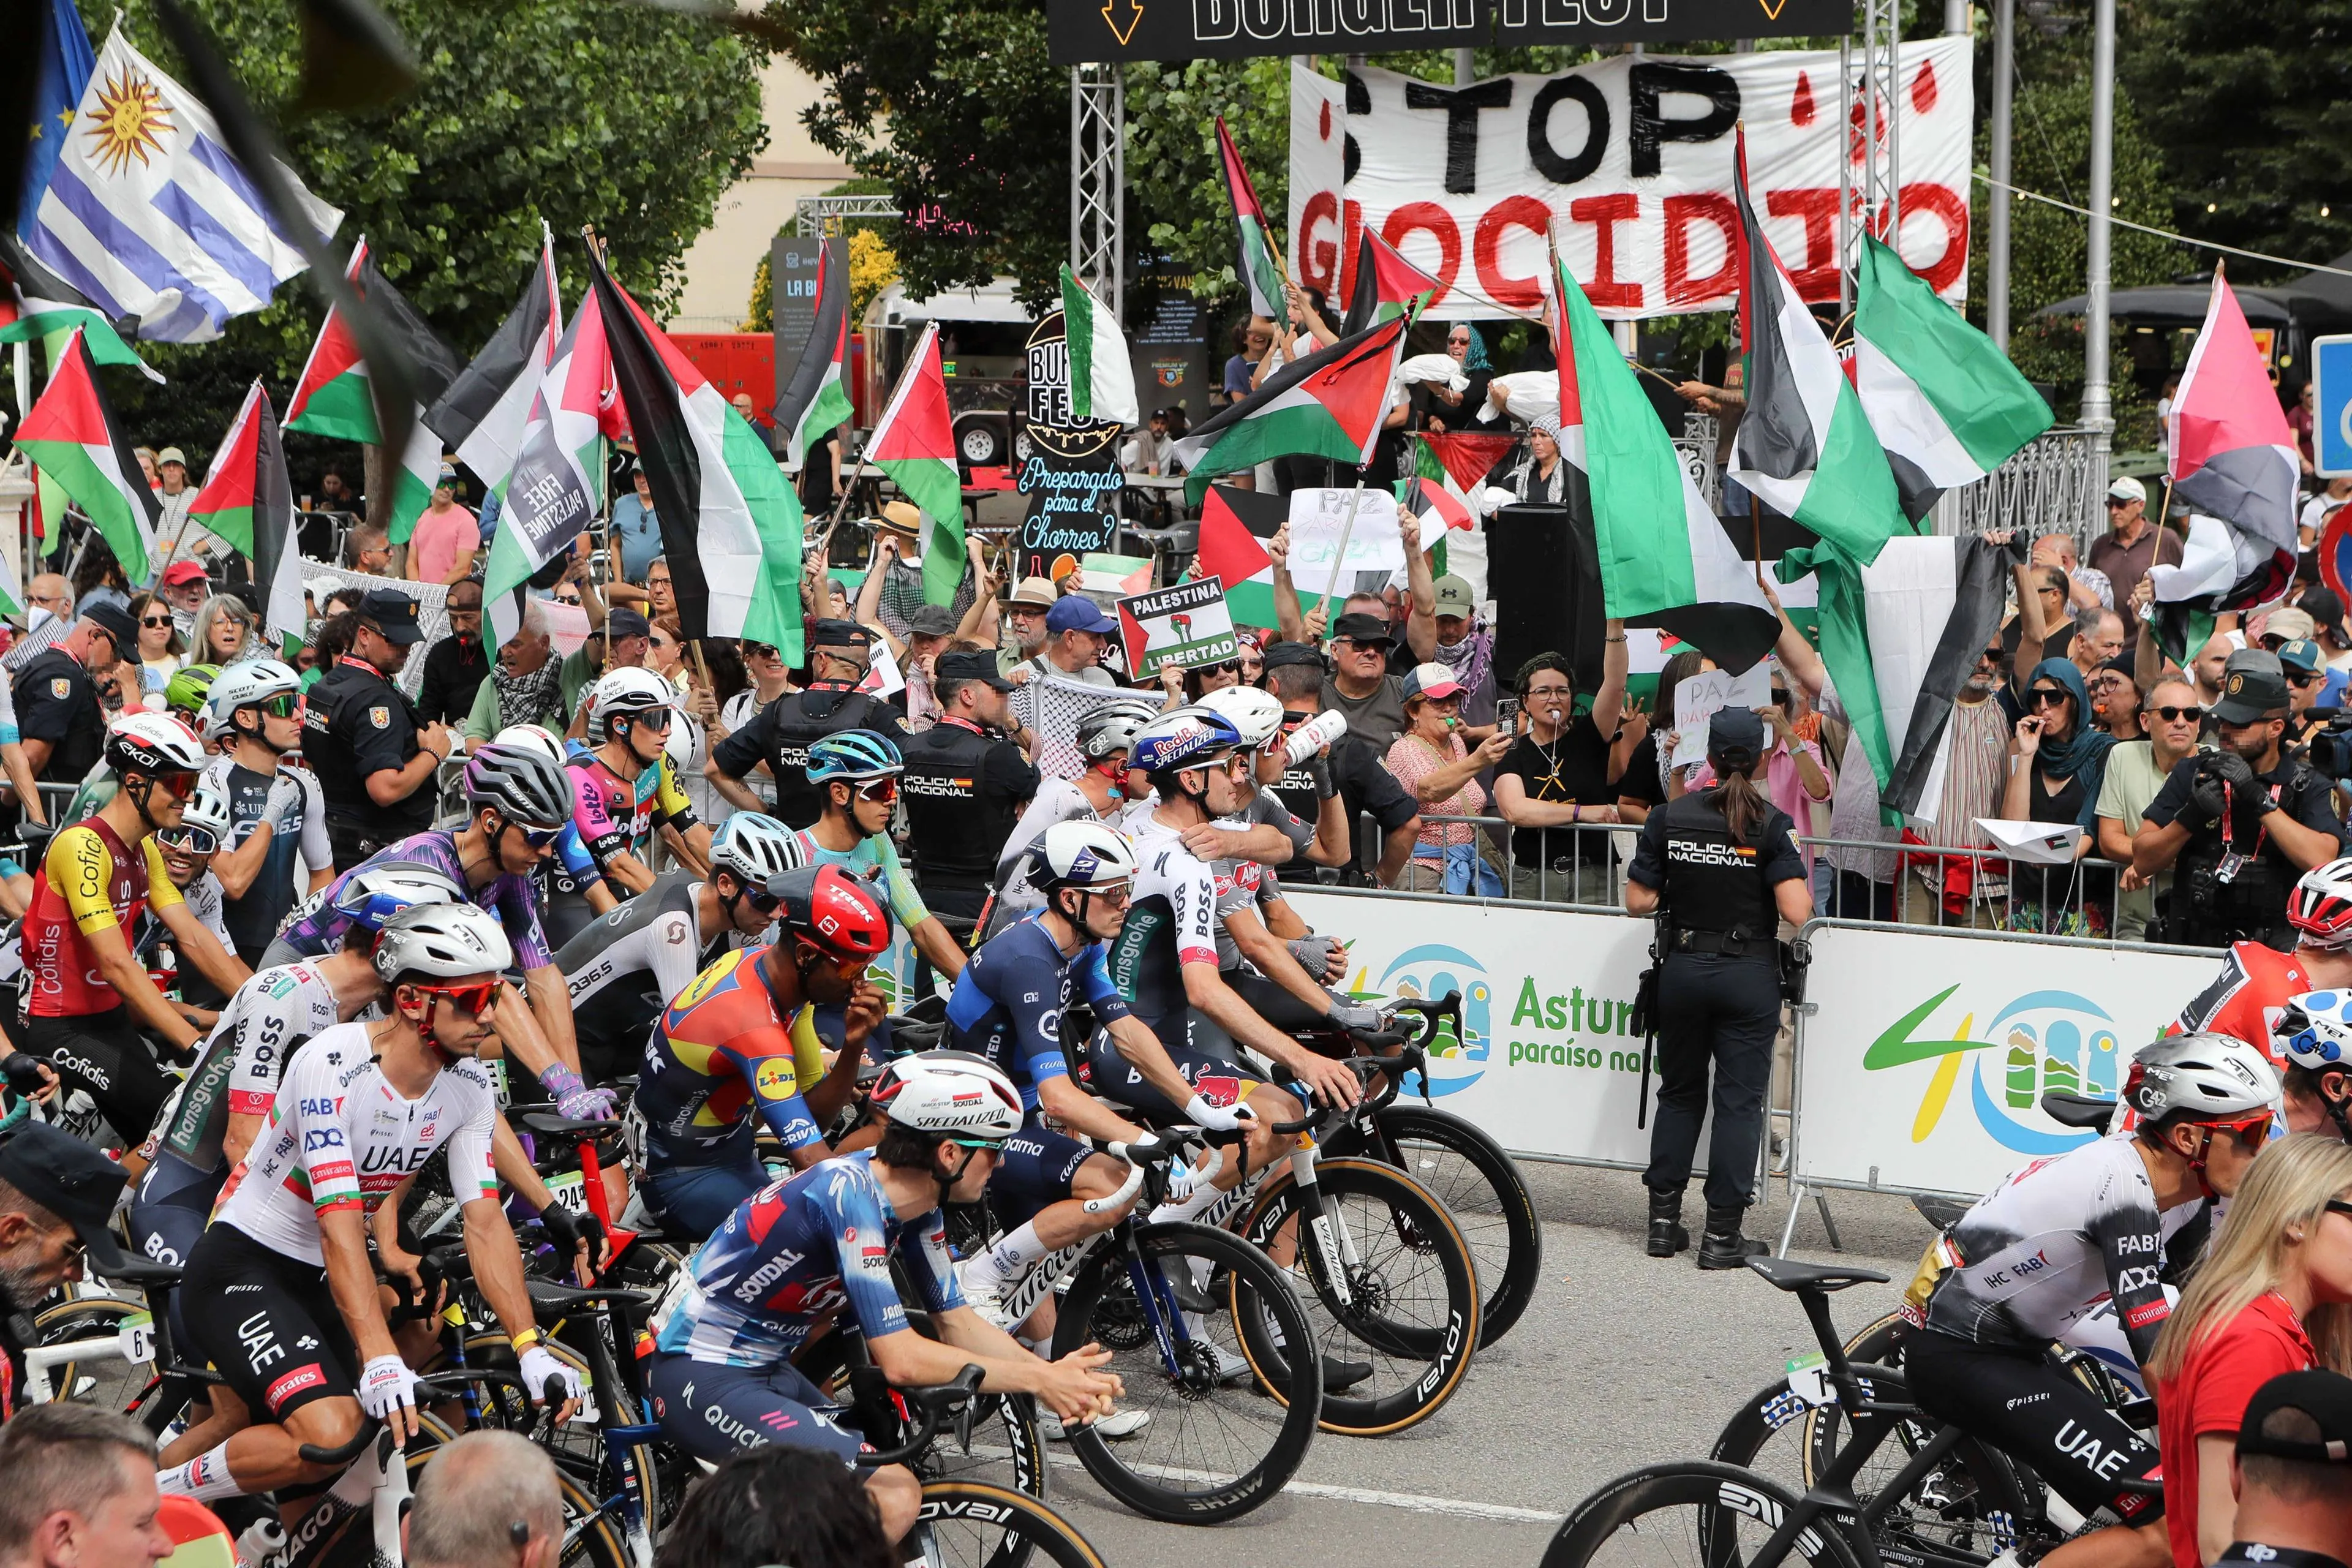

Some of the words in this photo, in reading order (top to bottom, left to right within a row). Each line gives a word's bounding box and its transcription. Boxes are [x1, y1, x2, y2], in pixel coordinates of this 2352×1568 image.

[1042, 497, 1079, 519] para
[1080, 489, 1095, 513] el
[1319, 491, 1383, 514] PAZ
[1133, 582, 1220, 616] PALESTINA
[1147, 641, 1234, 671] LIBERTAD
[228, 684, 257, 695] SCOTT
[135, 723, 165, 740] Cofidis
[1155, 733, 1183, 756] Red
[1155, 728, 1216, 769] SPECIALIZED
[638, 775, 657, 799] caps
[904, 775, 957, 787] POLICIA
[905, 785, 974, 797] NACIONAL
[503, 782, 537, 811] GIANT
[725, 847, 754, 872] SCOTT
[1668, 840, 1737, 856] POLICIA
[1668, 851, 1756, 867] NACIONAL
[80, 834, 102, 898] Cofidis
[1072, 865, 1093, 874] Julbo
[1012, 878, 1029, 896] IHC
[828, 884, 875, 923] TREK
[1173, 882, 1187, 939] BORA
[1196, 878, 1213, 938] BOSS
[385, 930, 410, 946] MET
[453, 924, 486, 954] MET
[36, 924, 62, 995] Cofidis
[376, 949, 398, 971] G42
[1299, 954, 1327, 974] WHOOP
[568, 960, 613, 1000] Q36.5
[2206, 987, 2236, 1023] VINGEGAARD
[2313, 1020, 2348, 1040] MET
[251, 1015, 286, 1078] BOSS
[1510, 1038, 1603, 1069] paraíso
[2297, 1034, 2331, 1058] G42
[52, 1047, 111, 1091] Cofidis
[347, 1061, 372, 1082] Analog
[452, 1067, 488, 1089] Analog
[759, 1071, 796, 1088] LIDL
[2146, 1067, 2178, 1082] MET
[2222, 1057, 2260, 1089] MET
[170, 1055, 236, 1146] hansgrohe
[953, 1098, 984, 1108] SOUDAL
[2139, 1087, 2168, 1109] G42
[669, 1091, 703, 1137] unbroken
[916, 1107, 1006, 1128] SPECIALIZED
[780, 1126, 820, 1147] CRIVIT
[262, 1158, 279, 1178] IHC
[361, 1145, 431, 1172] UAE
[311, 1165, 353, 1180] Emirates
[1318, 1219, 1347, 1290] SPECIALIZED
[736, 1248, 805, 1303] SOUDAL
[1983, 1270, 2011, 1289] IHC
[232, 1284, 263, 1293] PISSEI
[2131, 1302, 2169, 1324] Emirates
[1858, 1325, 1877, 1342] CORSA
[1877, 1319, 1890, 1330] PRO
[133, 1330, 143, 1358] 6
[238, 1310, 286, 1376] UAE
[1416, 1308, 1463, 1403] roval
[369, 1368, 399, 1379] UAE
[2017, 1392, 2051, 1407] PISSEI
[704, 1404, 770, 1450] QUICK
[2054, 1418, 2131, 1482] UAE
[1183, 1471, 1265, 1513] MICHE
[1596, 1489, 1615, 1507] PRIX
[1836, 1513, 1856, 1526] UAE
